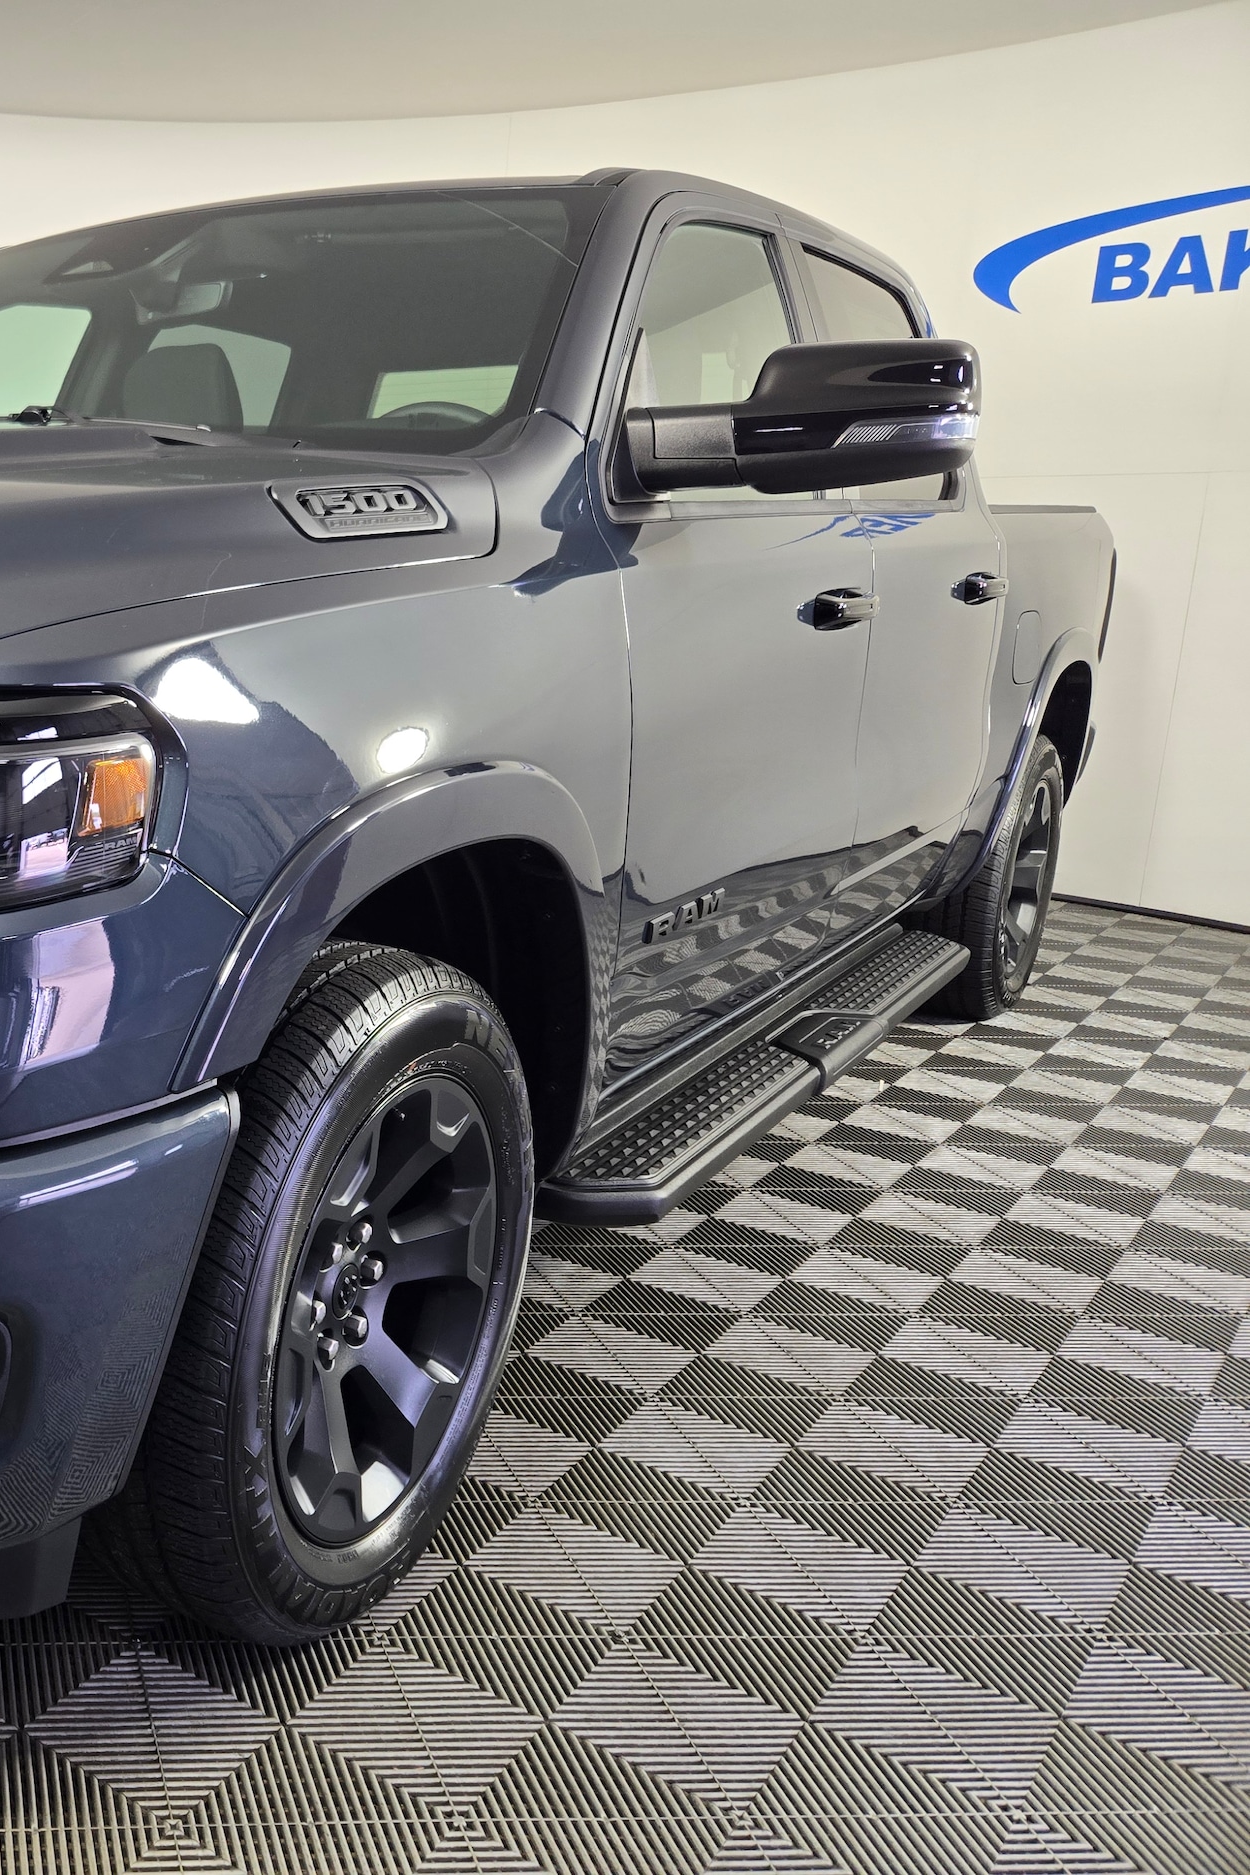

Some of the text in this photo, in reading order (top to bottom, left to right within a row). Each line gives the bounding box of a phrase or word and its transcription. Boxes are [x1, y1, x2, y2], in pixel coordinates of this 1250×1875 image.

[301, 490, 417, 516] 1500
[104, 836, 138, 851] RAM
[642, 887, 725, 944] RAM
